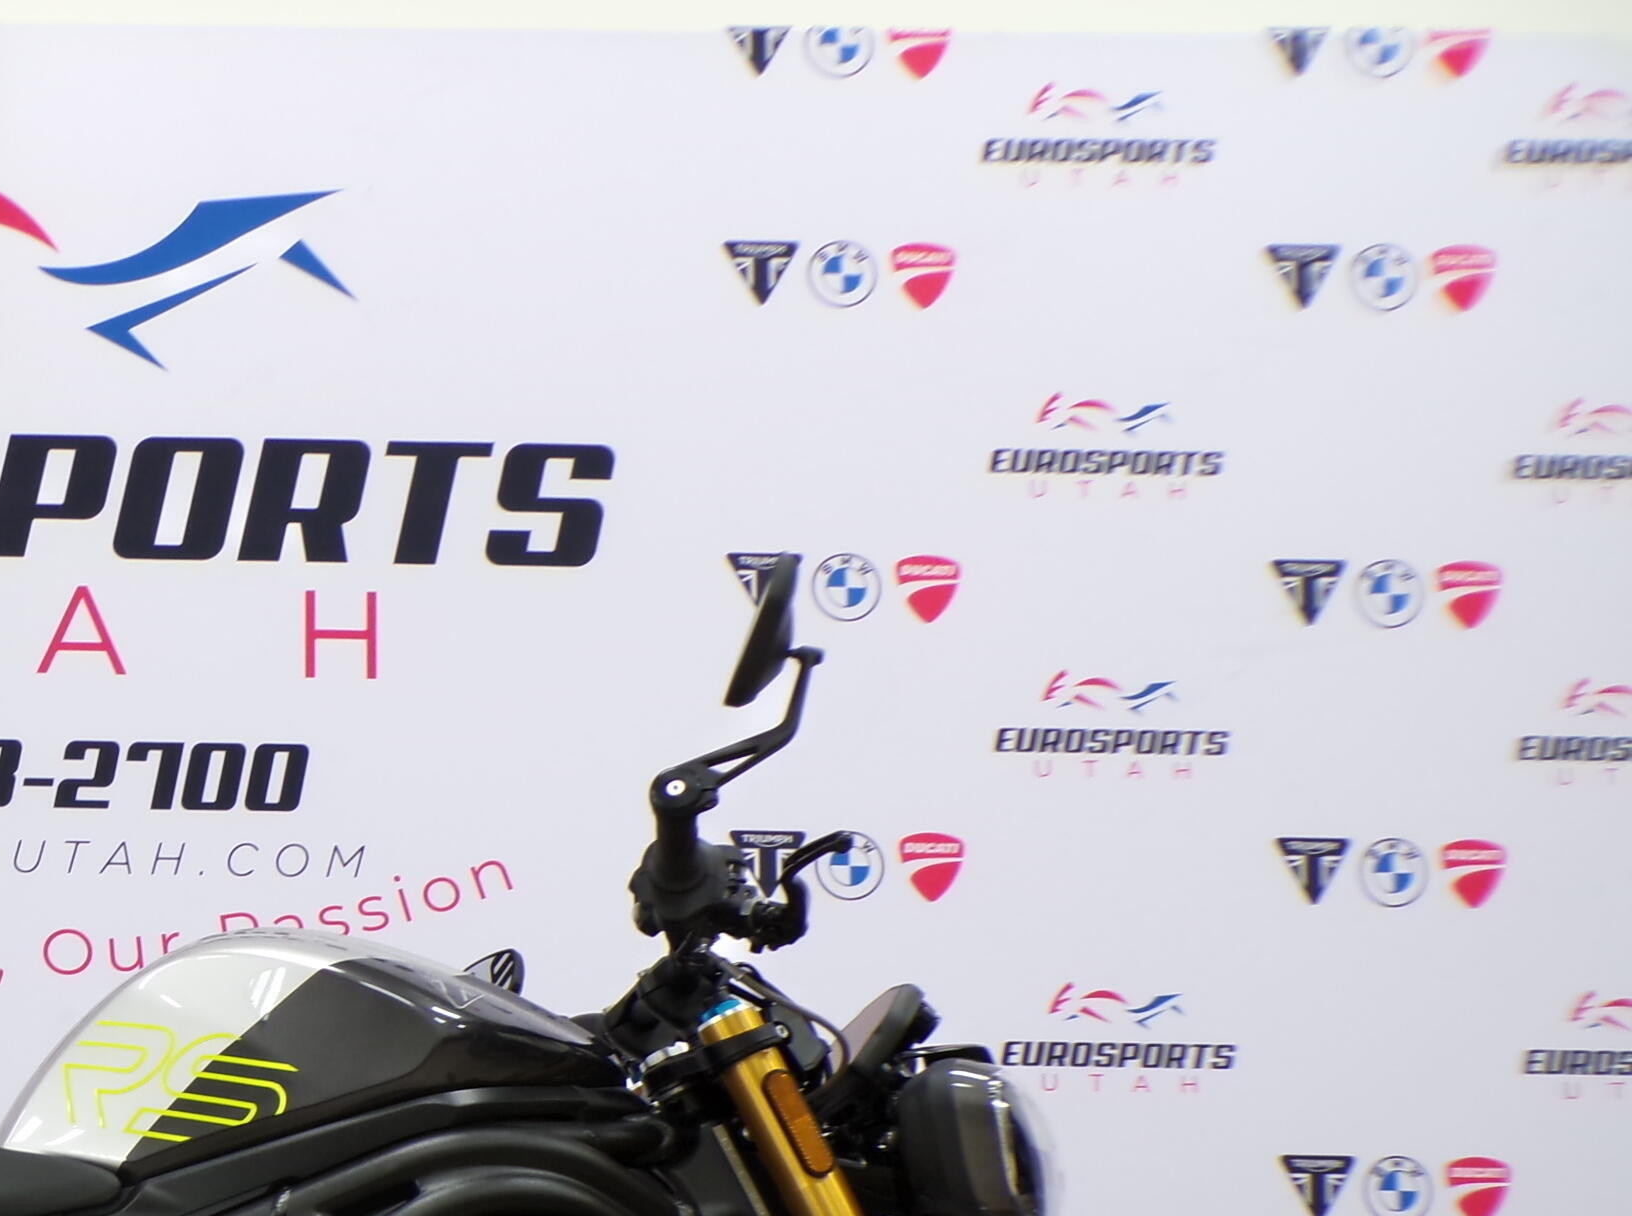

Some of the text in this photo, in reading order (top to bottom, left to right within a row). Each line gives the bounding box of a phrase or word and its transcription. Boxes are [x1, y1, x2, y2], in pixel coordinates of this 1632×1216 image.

[982, 139, 1214, 163] EUROSPORTS
[990, 449, 1223, 475] EUROSPORTS
[1513, 455, 1632, 480] EUROS
[1030, 480, 1188, 499] UTAH
[901, 564, 954, 576] DUCATI
[995, 728, 1228, 755] EUROSPORTS
[1037, 760, 1193, 779] UTAH
[741, 834, 793, 845] TRIUMPH
[904, 842, 959, 854] DUCATI
[43, 928, 181, 976] Our
[1001, 1042, 1235, 1069] EUROSPORTS
[62, 1020, 299, 1142] RS
[1041, 1073, 1200, 1092] UTAH
